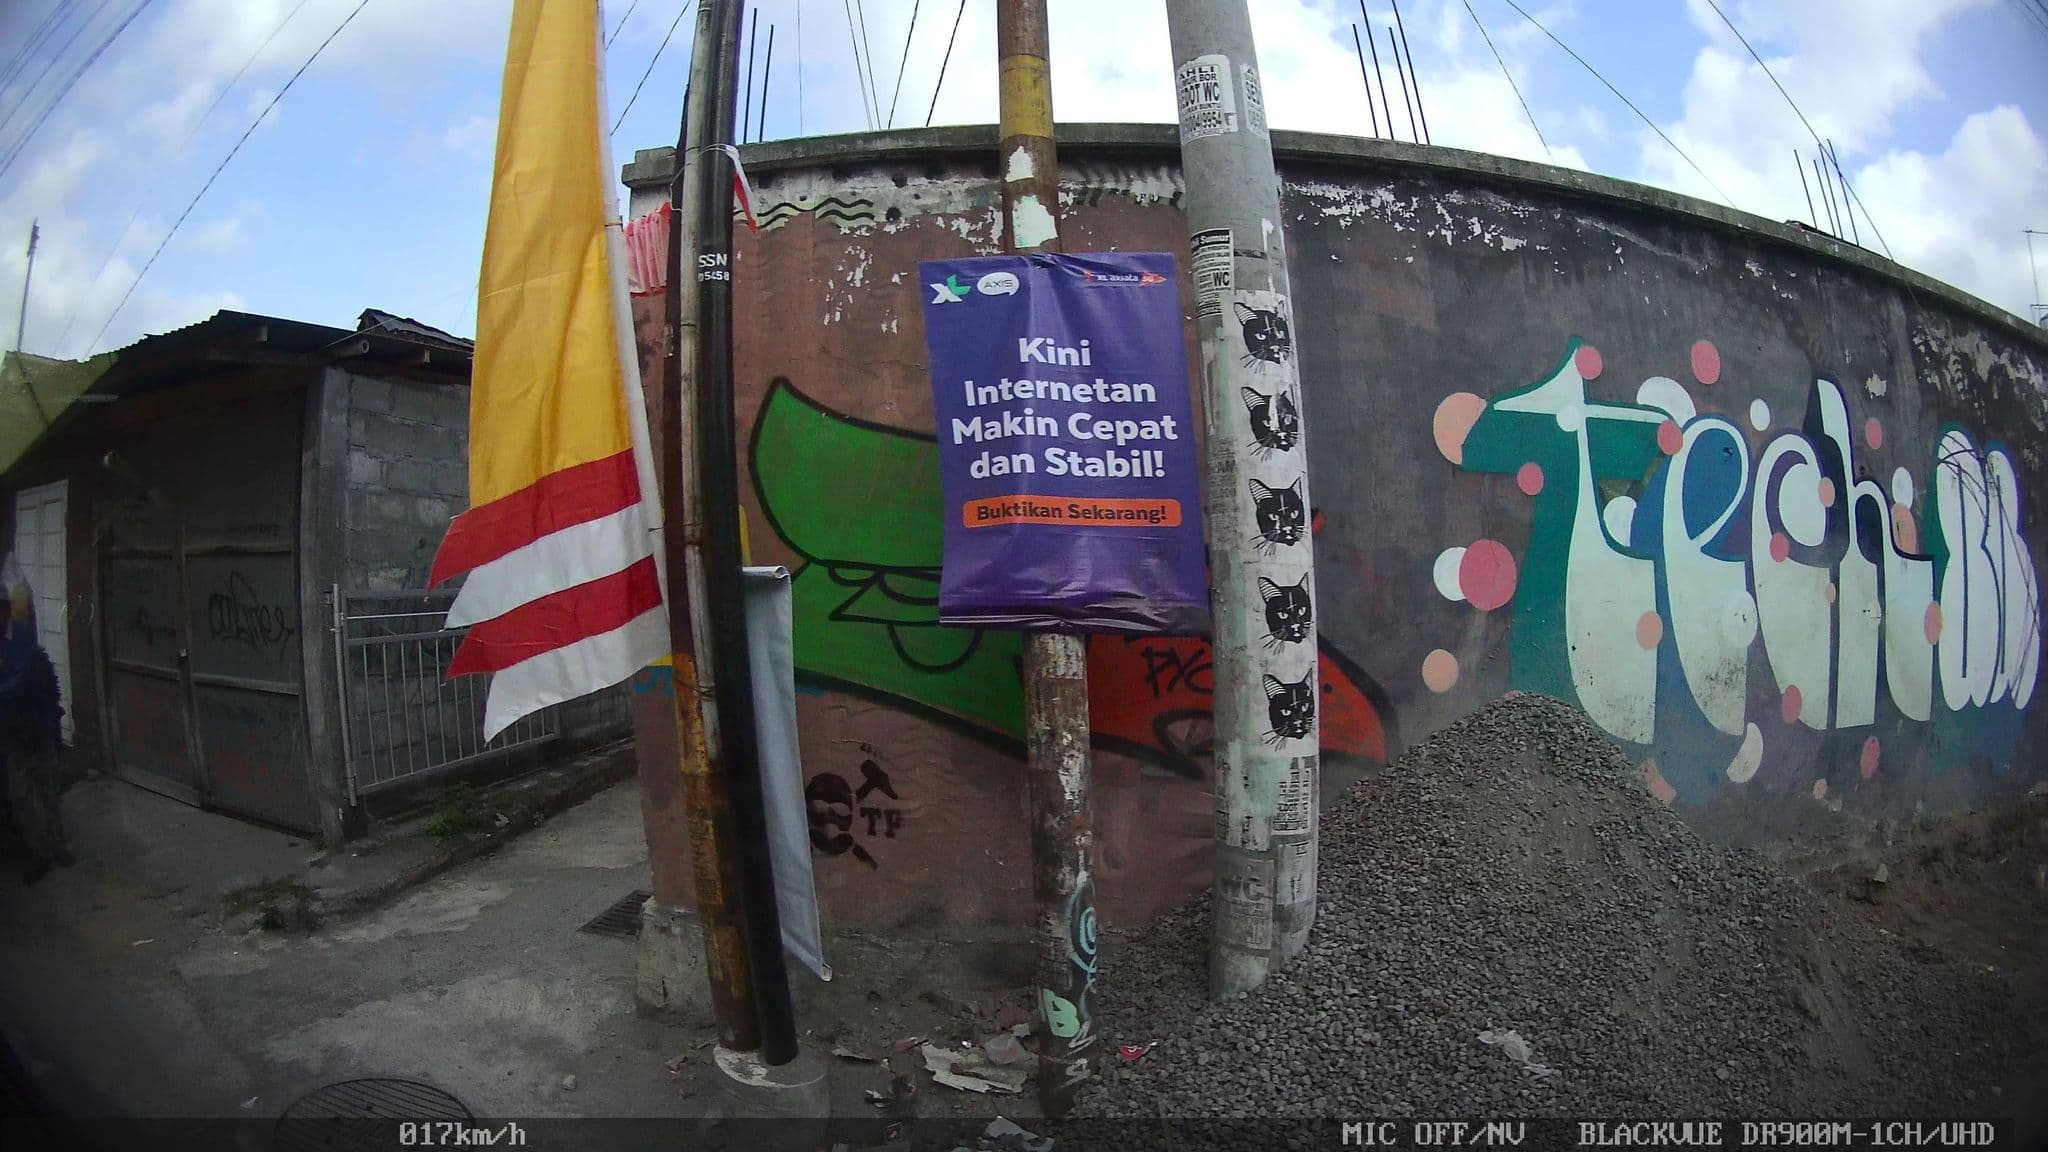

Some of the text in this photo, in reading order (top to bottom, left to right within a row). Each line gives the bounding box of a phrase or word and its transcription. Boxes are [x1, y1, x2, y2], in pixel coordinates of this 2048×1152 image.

[698, 253, 728, 268] SSN
[930, 274, 1014, 304] XL AXIS
[1018, 337, 1091, 366] Kini
[965, 378, 1157, 407] Internetan
[952, 408, 1179, 445] Makin Cepat
[970, 447, 1165, 479] dan Stabil!
[977, 502, 1167, 523] Buktikan Sekarang!
